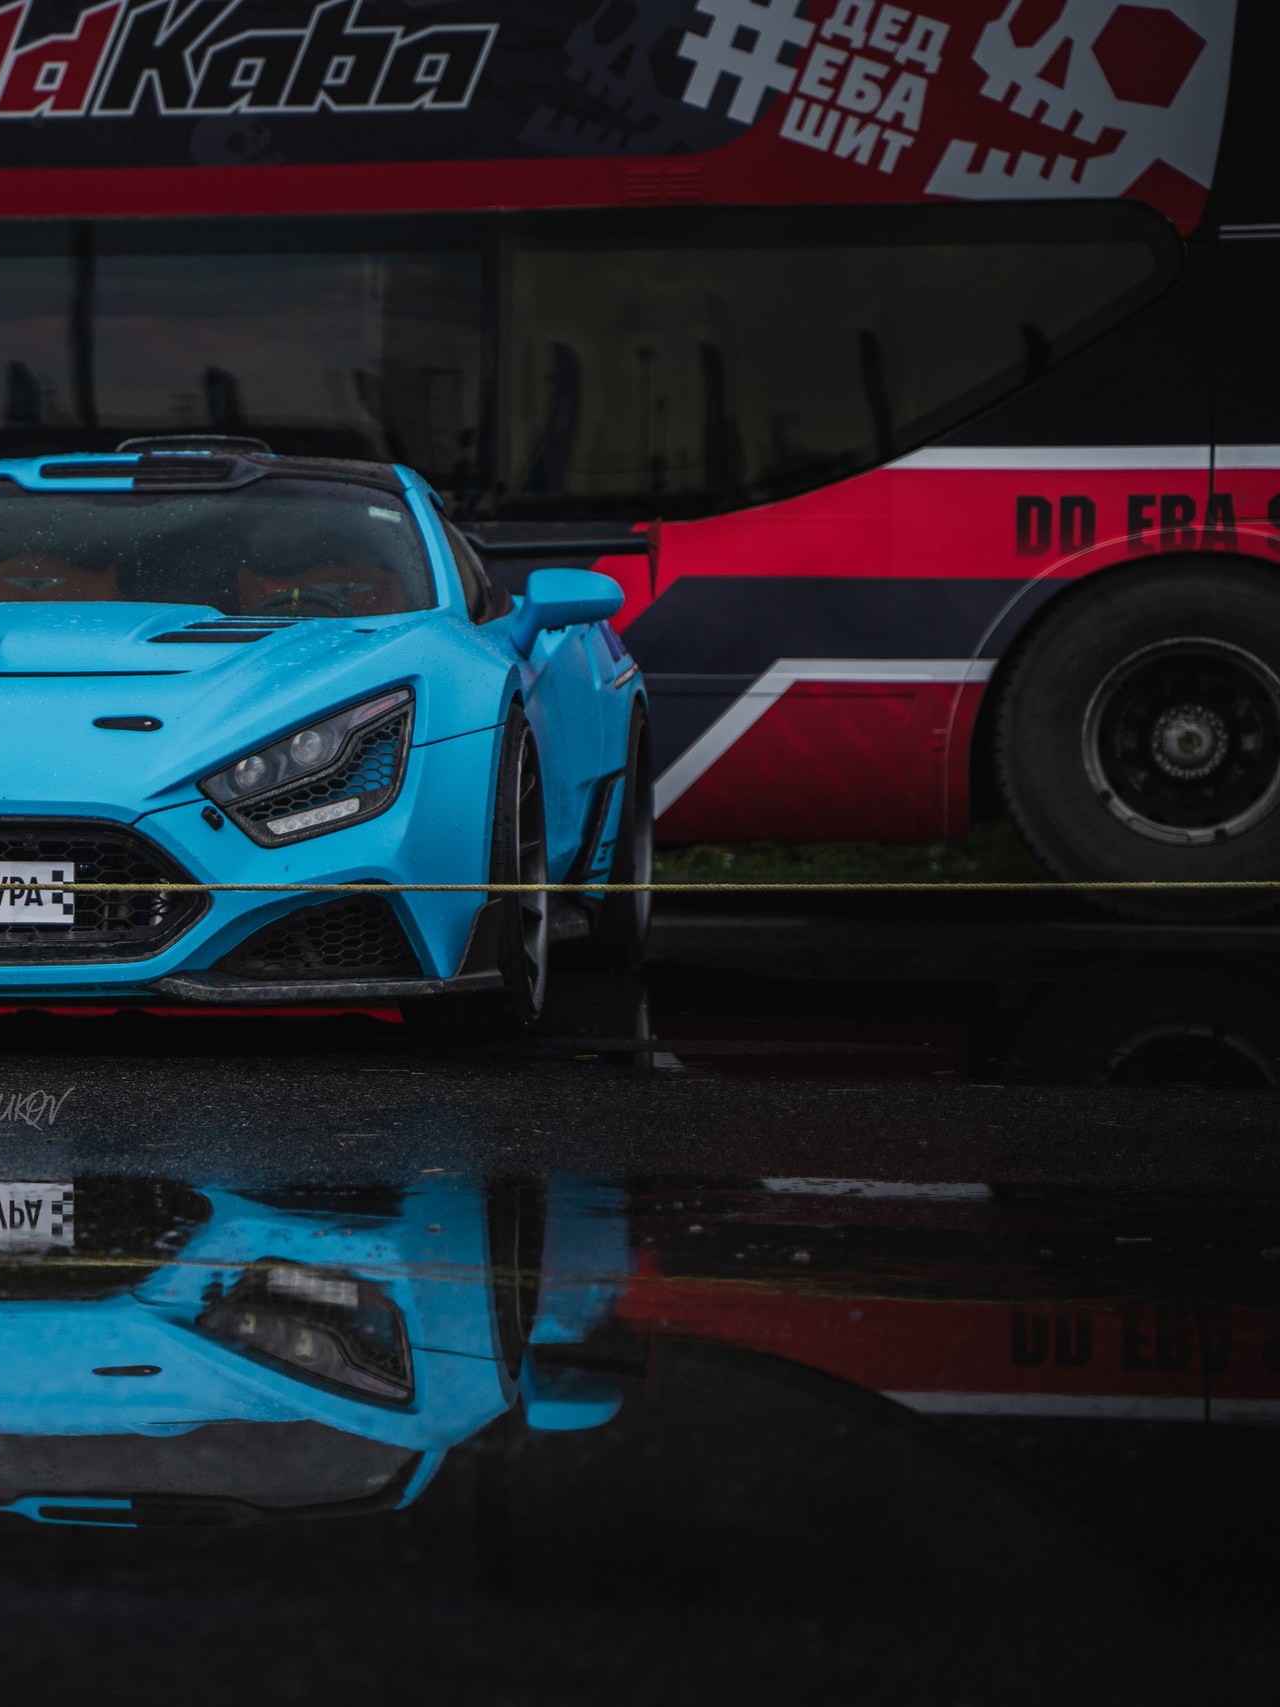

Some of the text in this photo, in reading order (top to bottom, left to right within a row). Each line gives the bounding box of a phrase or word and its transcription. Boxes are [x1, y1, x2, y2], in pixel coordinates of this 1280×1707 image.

[819, 0, 951, 75] ДЕД
[797, 41, 929, 133] ЕБА
[778, 96, 917, 175] ШИТ
[1016, 495, 1096, 558] DD
